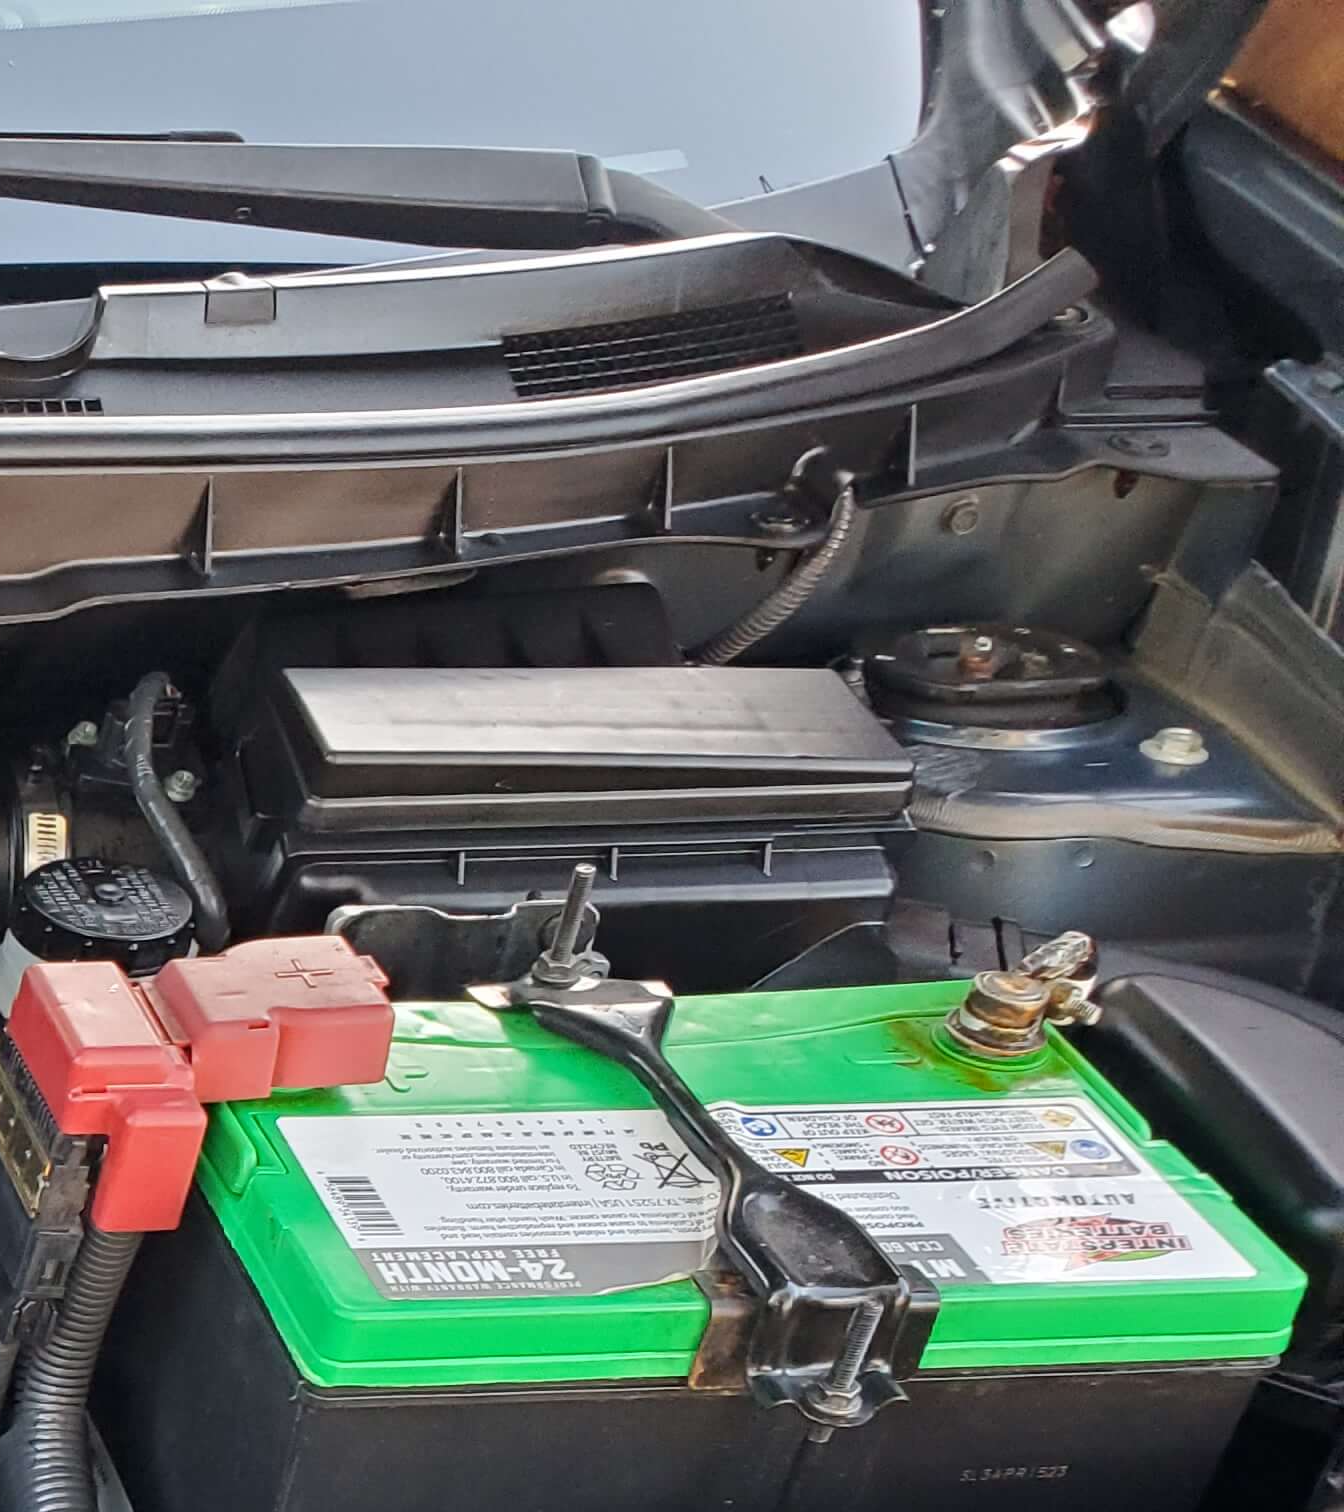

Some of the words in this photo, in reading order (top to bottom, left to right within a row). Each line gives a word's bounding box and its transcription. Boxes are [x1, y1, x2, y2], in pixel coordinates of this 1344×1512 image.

[639, 1142, 669, 1151] Pb
[496, 1166, 513, 1174] call
[514, 1165, 555, 1173] Canada
[883, 1166, 1069, 1180] DANGER/POISON
[527, 1184, 564, 1192] replace
[565, 1183, 581, 1191] To
[975, 1193, 1136, 1209] AUTOMOTIVE
[1007, 1224, 1169, 1239] BATTERIES
[879, 1242, 901, 1253] 60
[905, 1240, 944, 1252] CCA
[1006, 1238, 1186, 1256] INTERSTATE
[370, 1249, 506, 1263] REPLACEMENT
[511, 1248, 561, 1260] FREE
[375, 1259, 575, 1284] 24-MONTH
[389, 1284, 422, 1293] WITH
[426, 1282, 493, 1292] WARRANTY
[495, 1280, 582, 1291] PERFORMANCE
